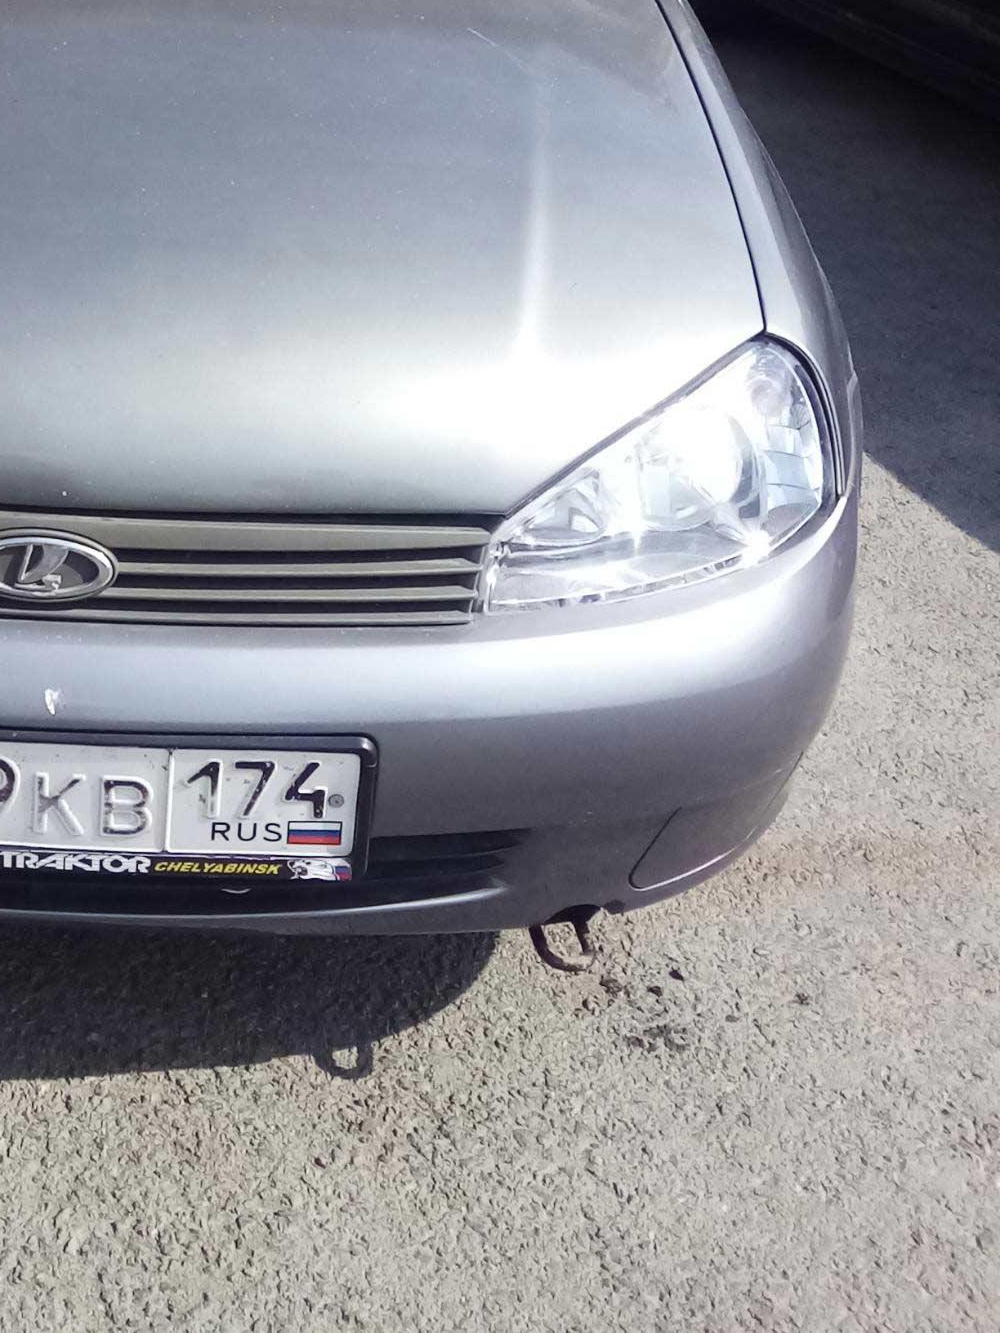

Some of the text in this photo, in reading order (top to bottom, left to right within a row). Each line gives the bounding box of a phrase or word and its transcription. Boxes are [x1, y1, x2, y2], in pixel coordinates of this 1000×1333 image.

[183, 759, 328, 818] 174
[211, 821, 282, 841] RUS
[0, 849, 152, 875] TRAKTOR
[154, 860, 283, 876] CHELYABINSK
